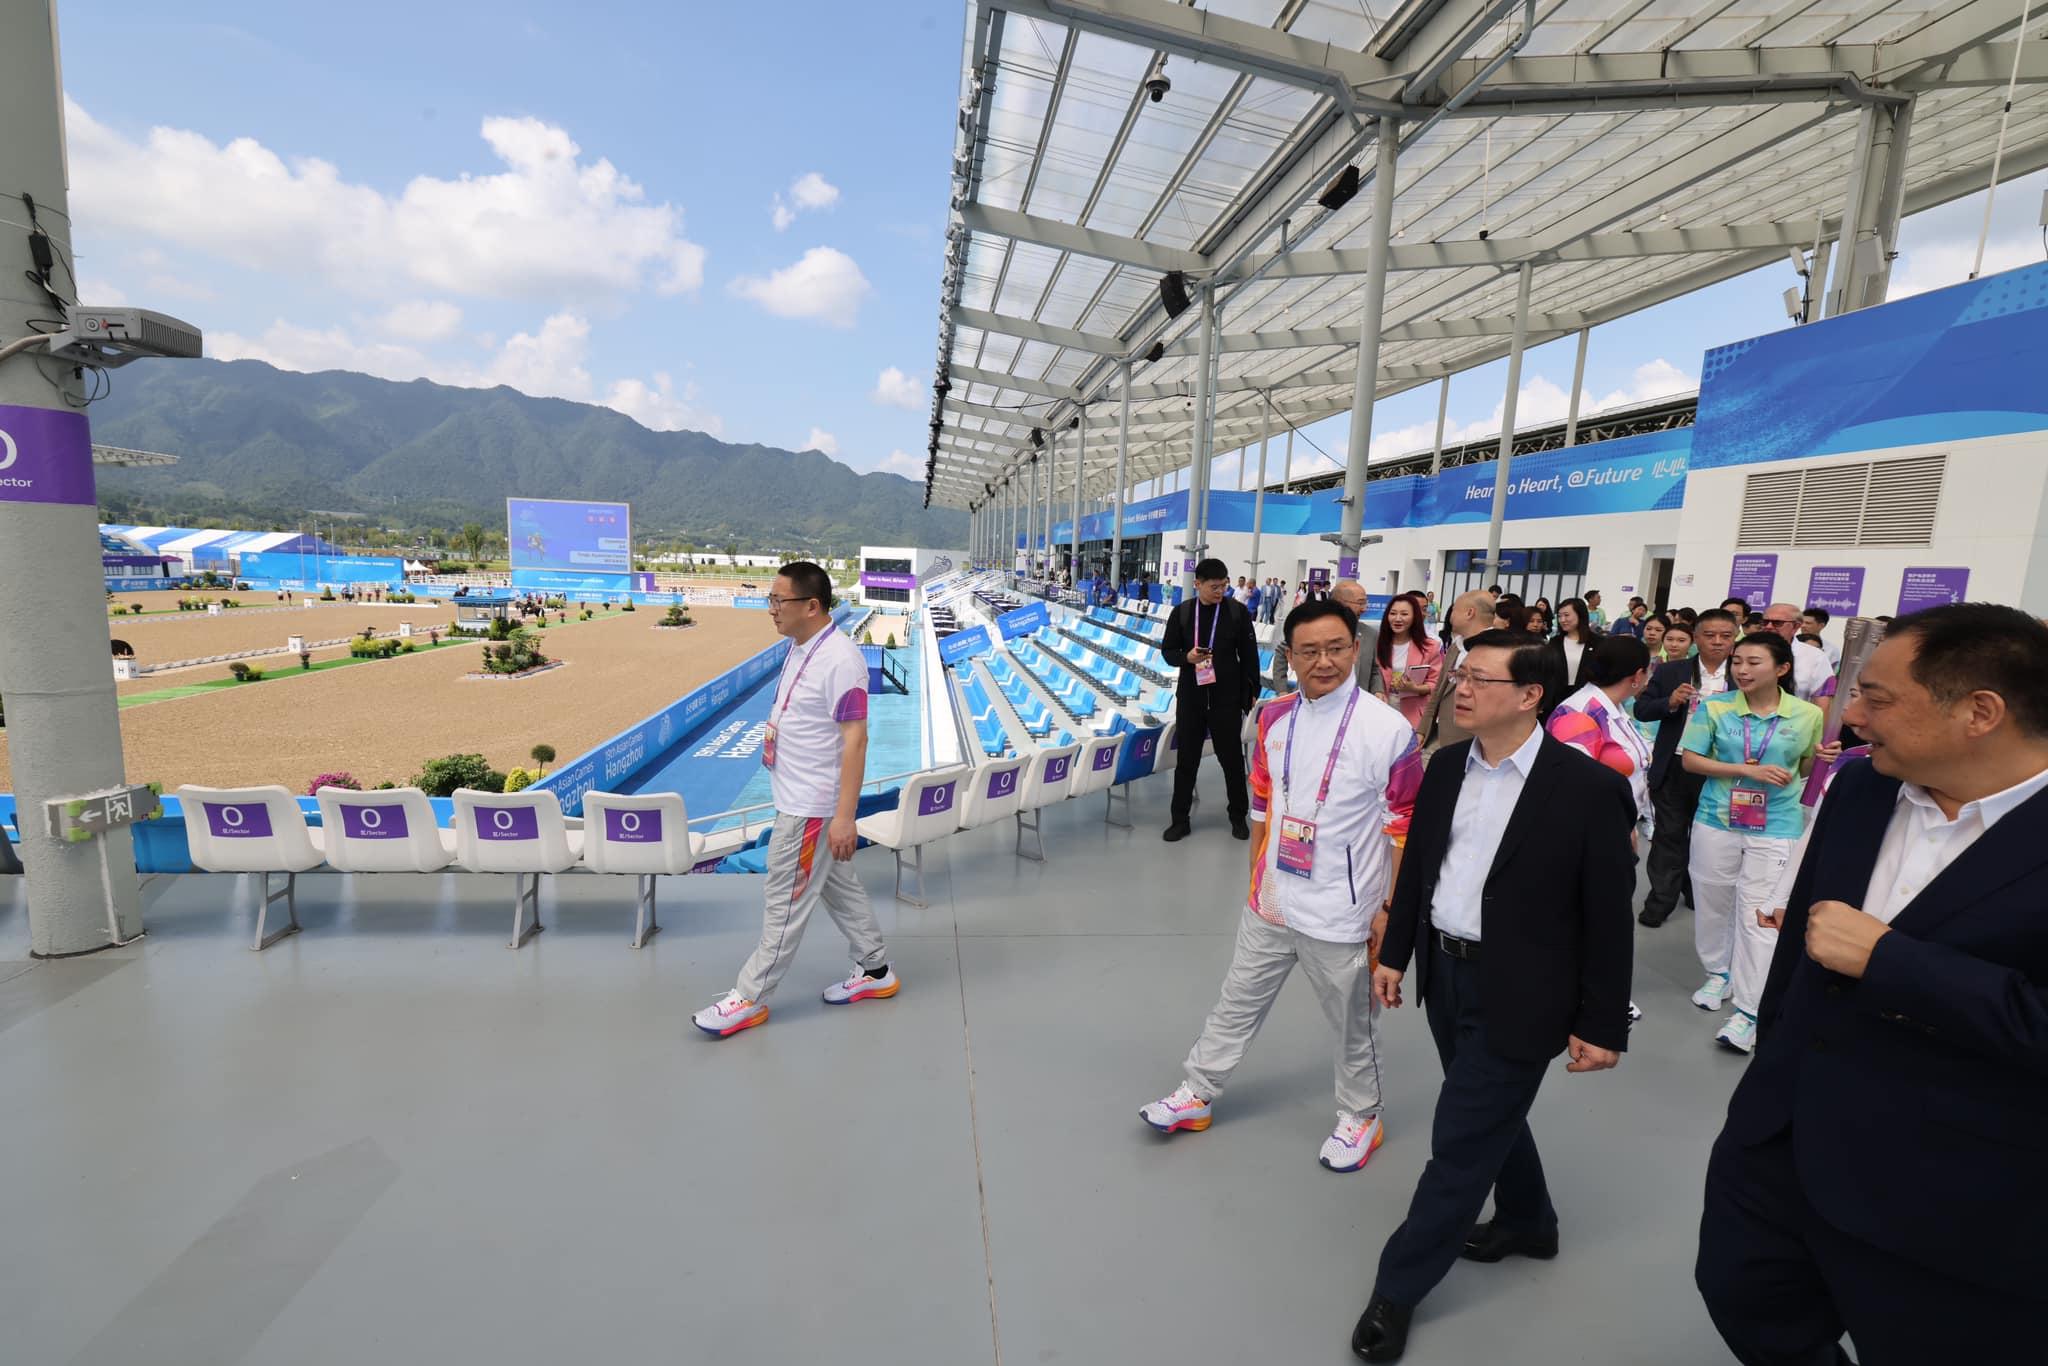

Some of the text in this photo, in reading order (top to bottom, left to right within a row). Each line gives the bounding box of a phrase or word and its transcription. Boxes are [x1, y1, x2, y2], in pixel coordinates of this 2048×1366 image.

[1465, 484, 1493, 500] Hear
[1518, 475, 1563, 494] Heart,
[1568, 465, 1644, 488] @Future
[575, 761, 594, 781] Games
[605, 745, 644, 781] Hangzhou
[1055, 758, 1064, 774] O
[1000, 772, 1011, 788] O
[934, 786, 946, 804] O
[222, 806, 244, 826] O
[360, 808, 382, 828] O
[493, 810, 514, 830] O
[621, 812, 640, 832] O
